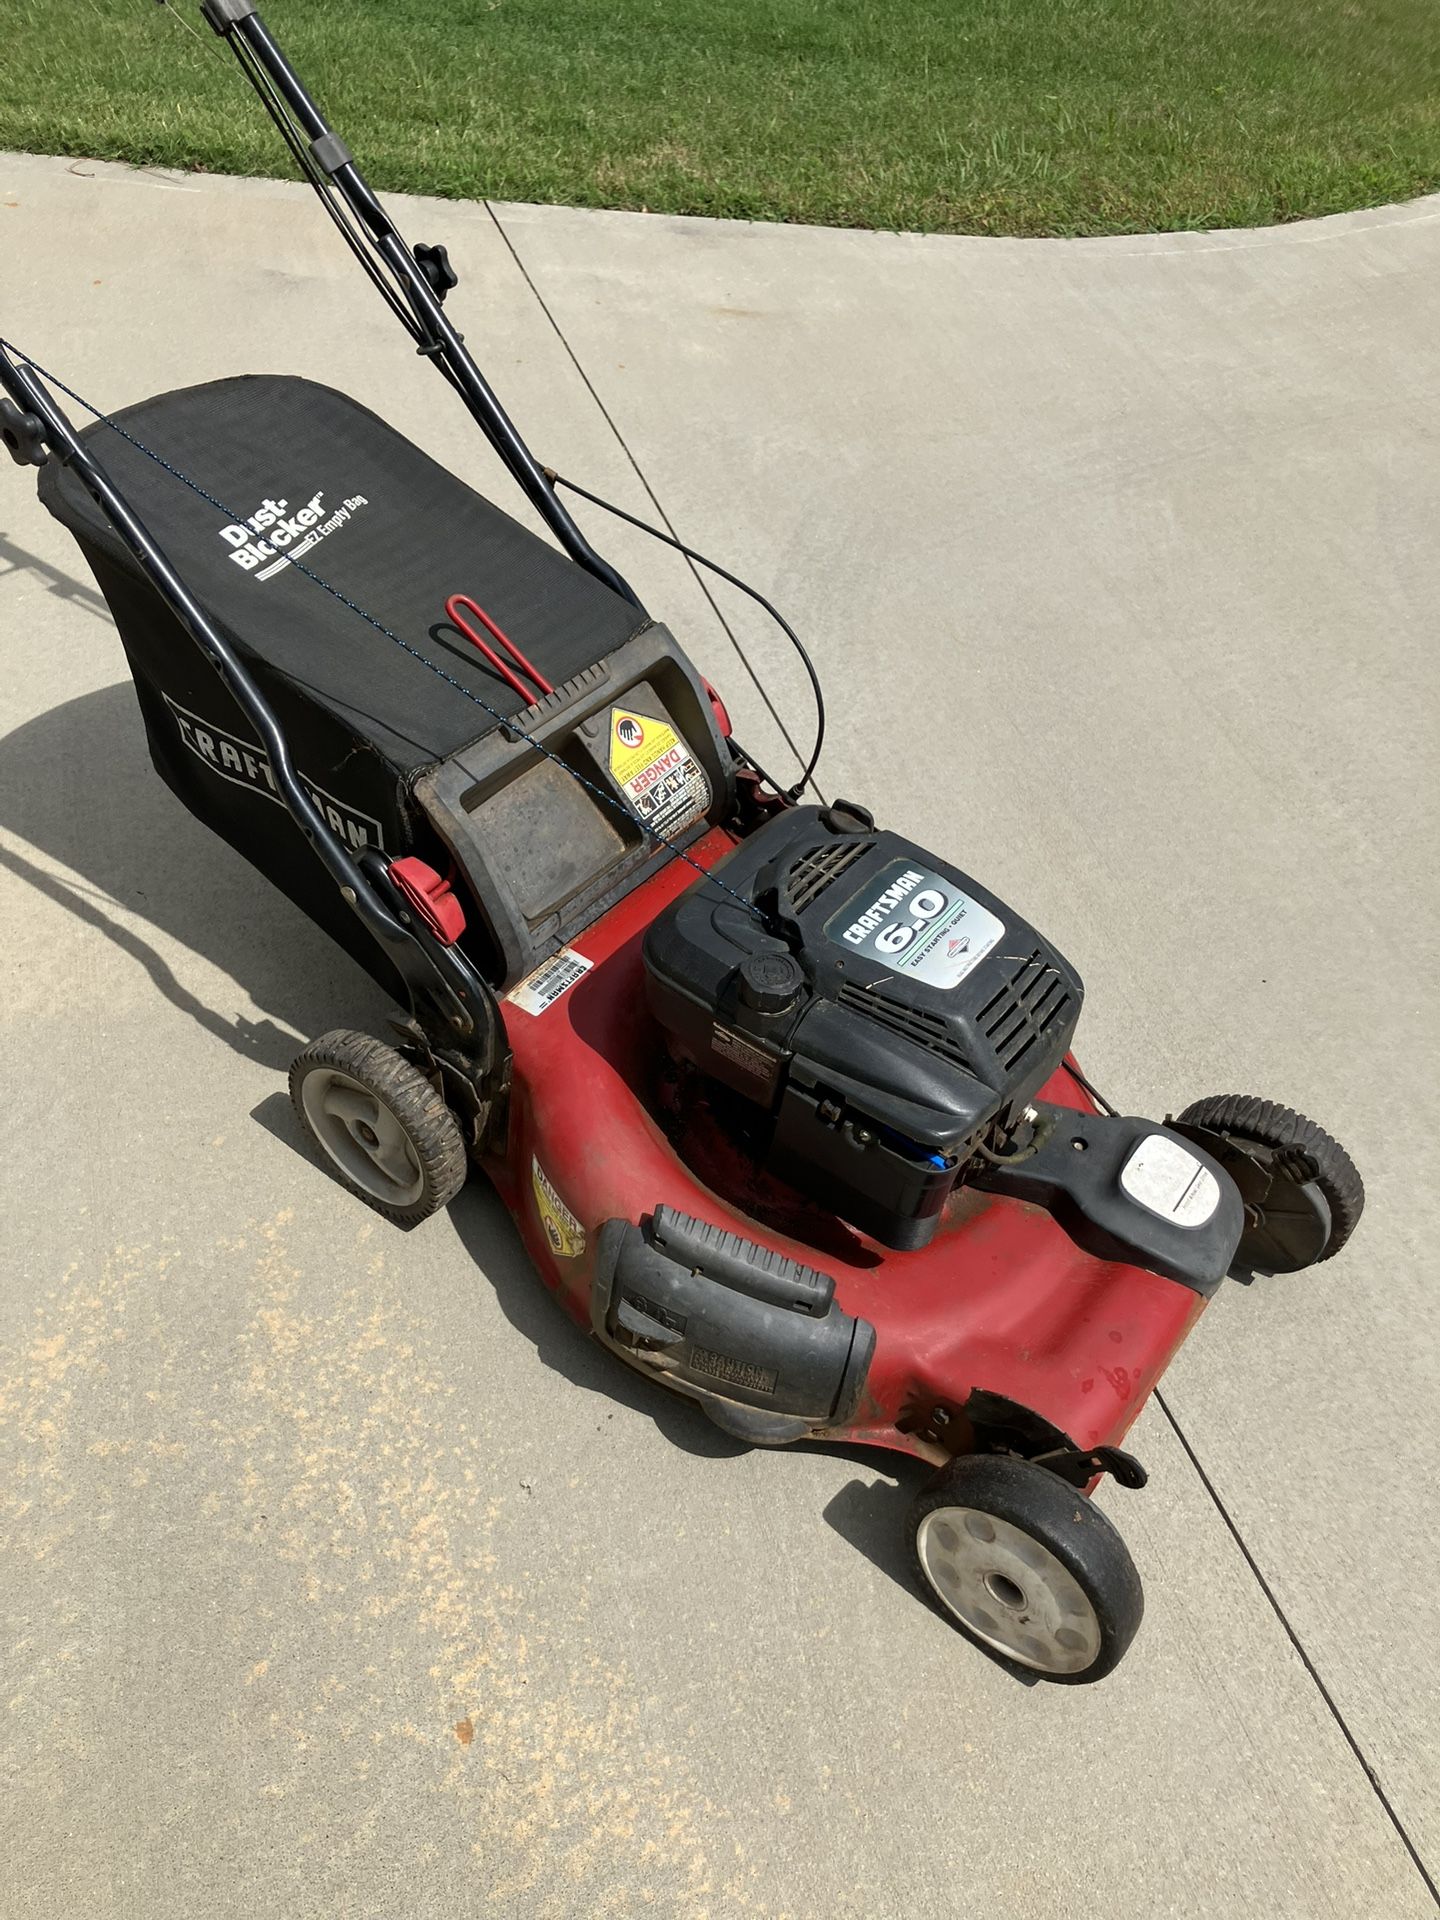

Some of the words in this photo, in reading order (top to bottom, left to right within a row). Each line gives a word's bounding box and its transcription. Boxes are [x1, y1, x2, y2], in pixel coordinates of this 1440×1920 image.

[218, 498, 288, 548] Dust-
[304, 530, 324, 544] EZ
[316, 506, 351, 536] Empty
[343, 494, 369, 511] Bag
[178, 717, 368, 849] RAFTAN
[630, 748, 681, 793] DANGER
[842, 869, 925, 945] CRAFTSMAN
[874, 889, 949, 954] 6.0
[910, 951, 926, 967] EASY
[924, 927, 950, 953] STARTING
[950, 909, 968, 926] QUIET
[546, 965, 587, 1001] CRAFTSMAN
